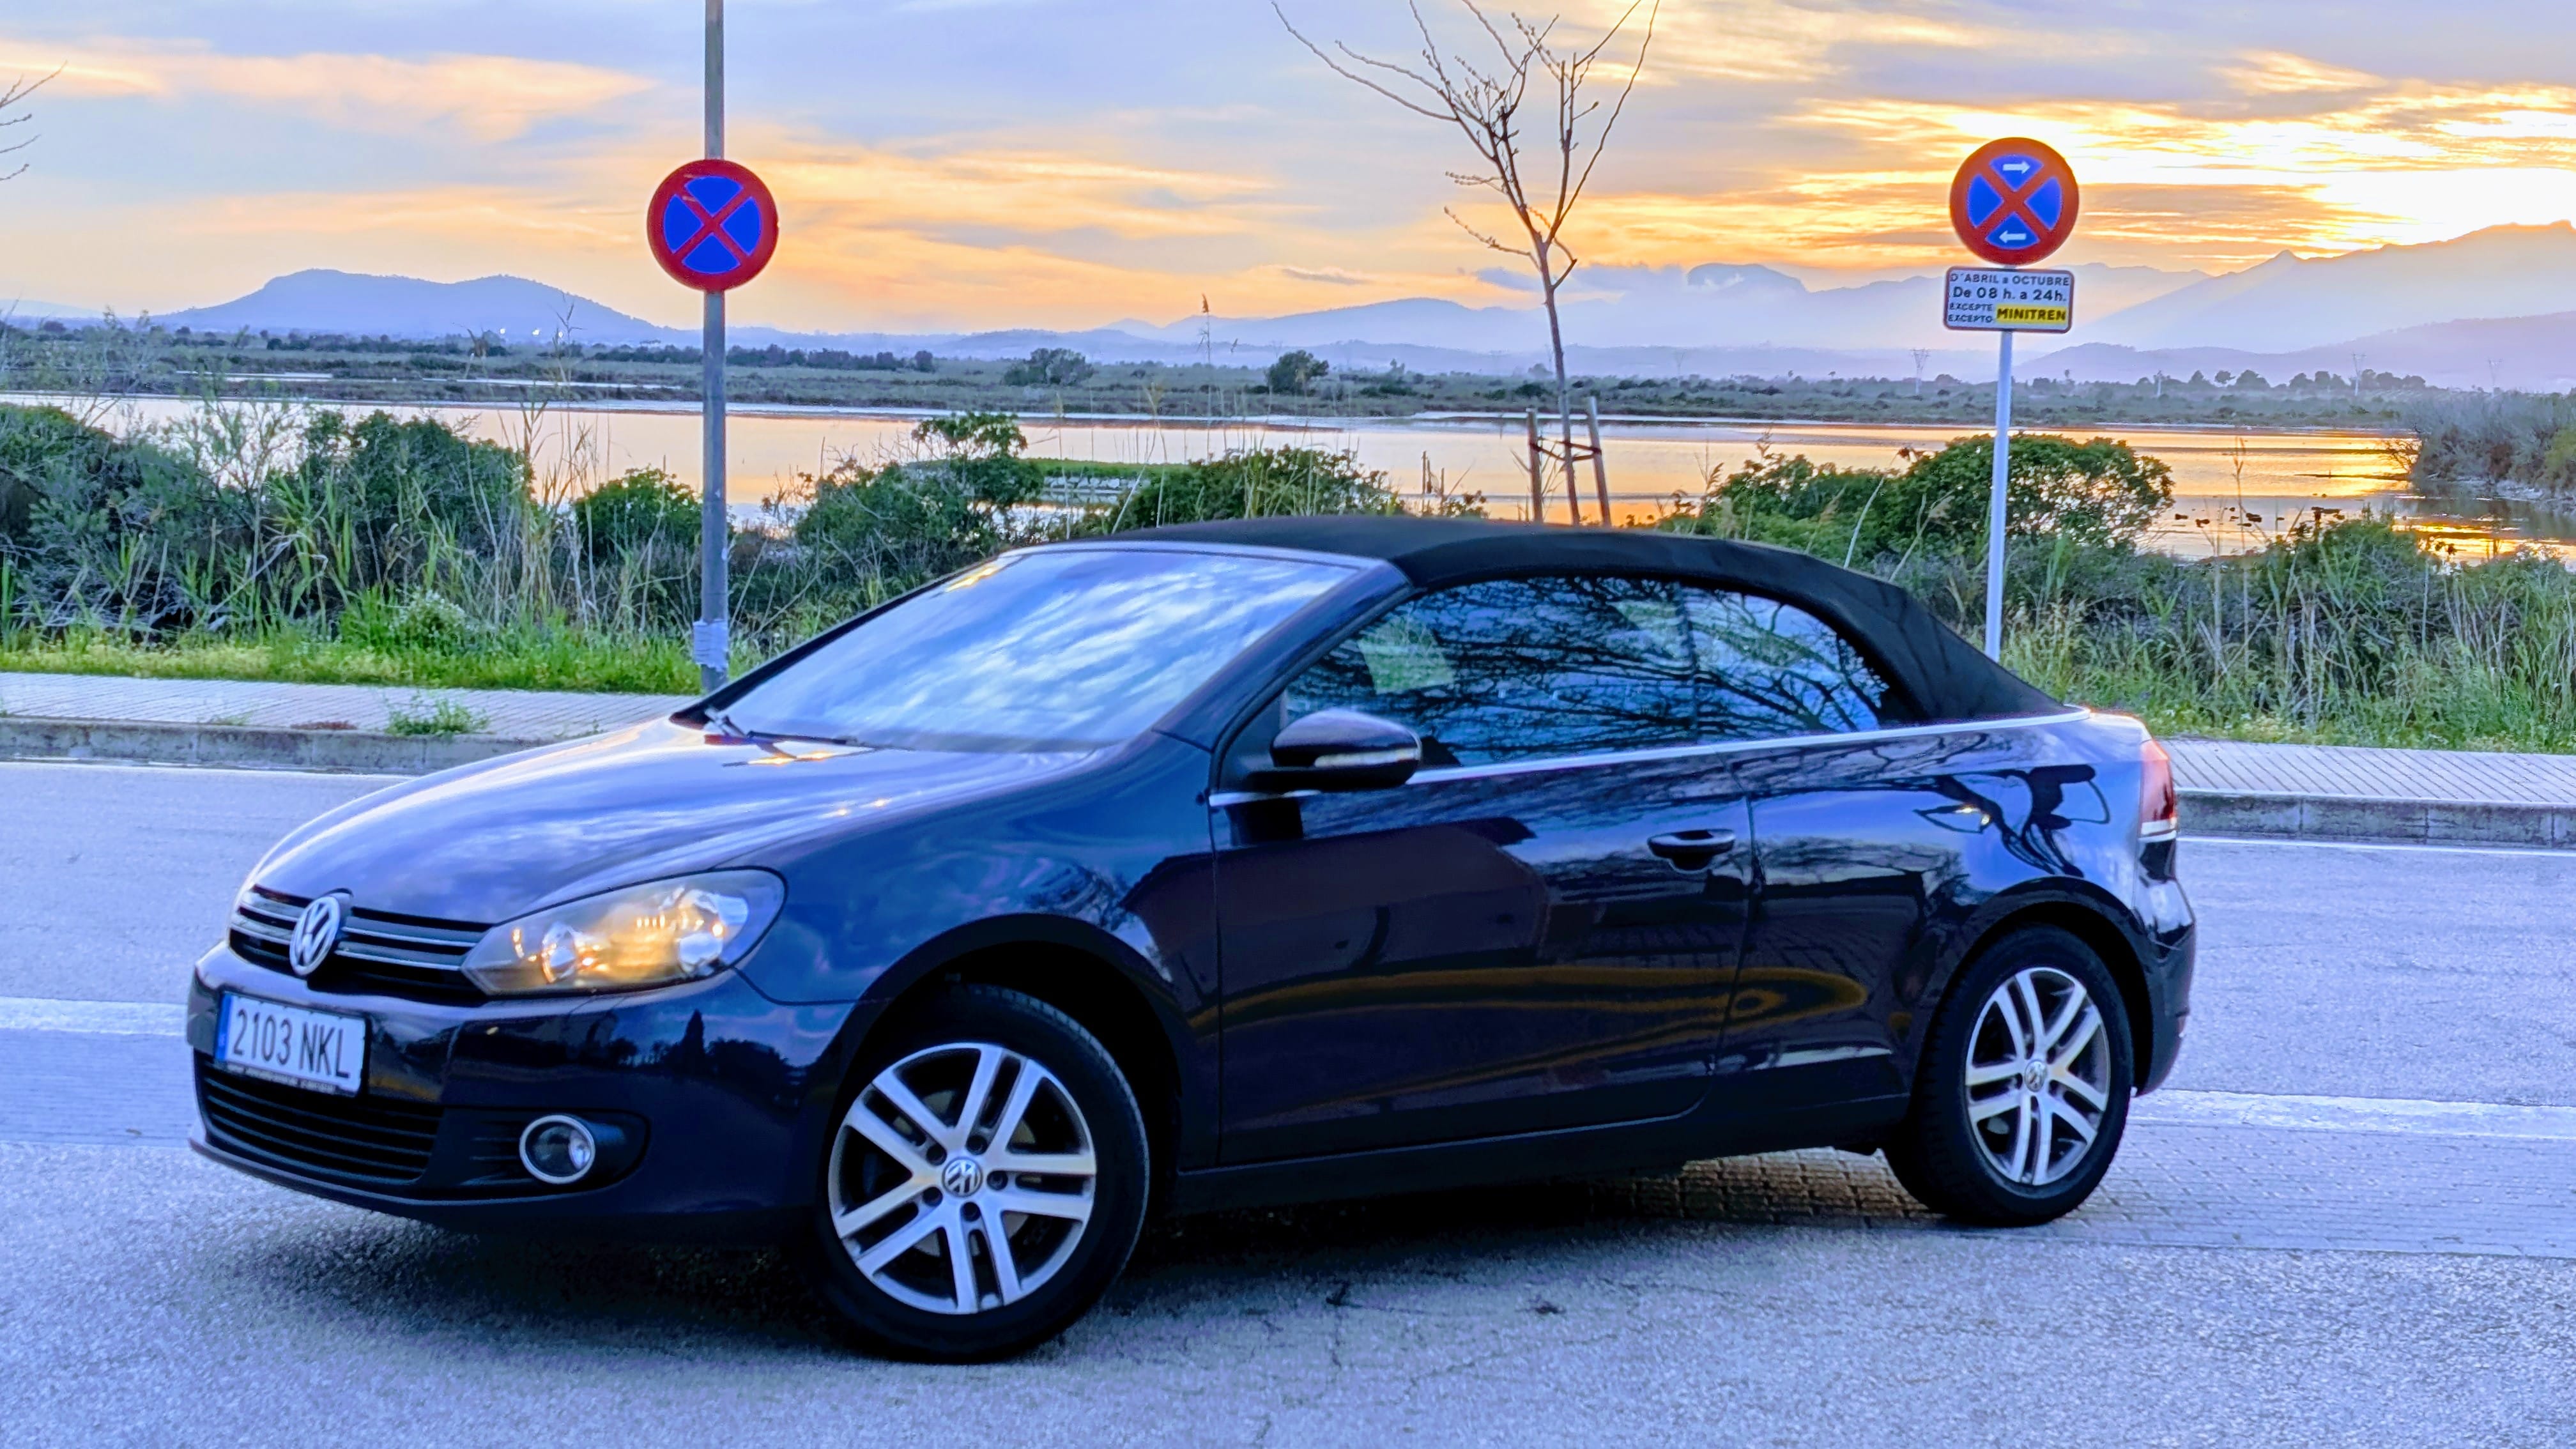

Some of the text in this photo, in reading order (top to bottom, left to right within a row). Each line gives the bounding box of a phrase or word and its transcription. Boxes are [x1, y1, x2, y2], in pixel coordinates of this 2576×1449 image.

[2012, 275, 2070, 286] OCTUBRE
[1953, 286, 1971, 298] De
[1977, 287, 1997, 299] 08
[2020, 291, 2027, 300] a
[1950, 302, 1993, 312] EXCEPTE
[1948, 314, 1993, 323] EXCEPTO
[1997, 308, 2067, 321] MINITREN
[233, 1008, 293, 1066] 2103
[298, 1021, 351, 1080] NKL
